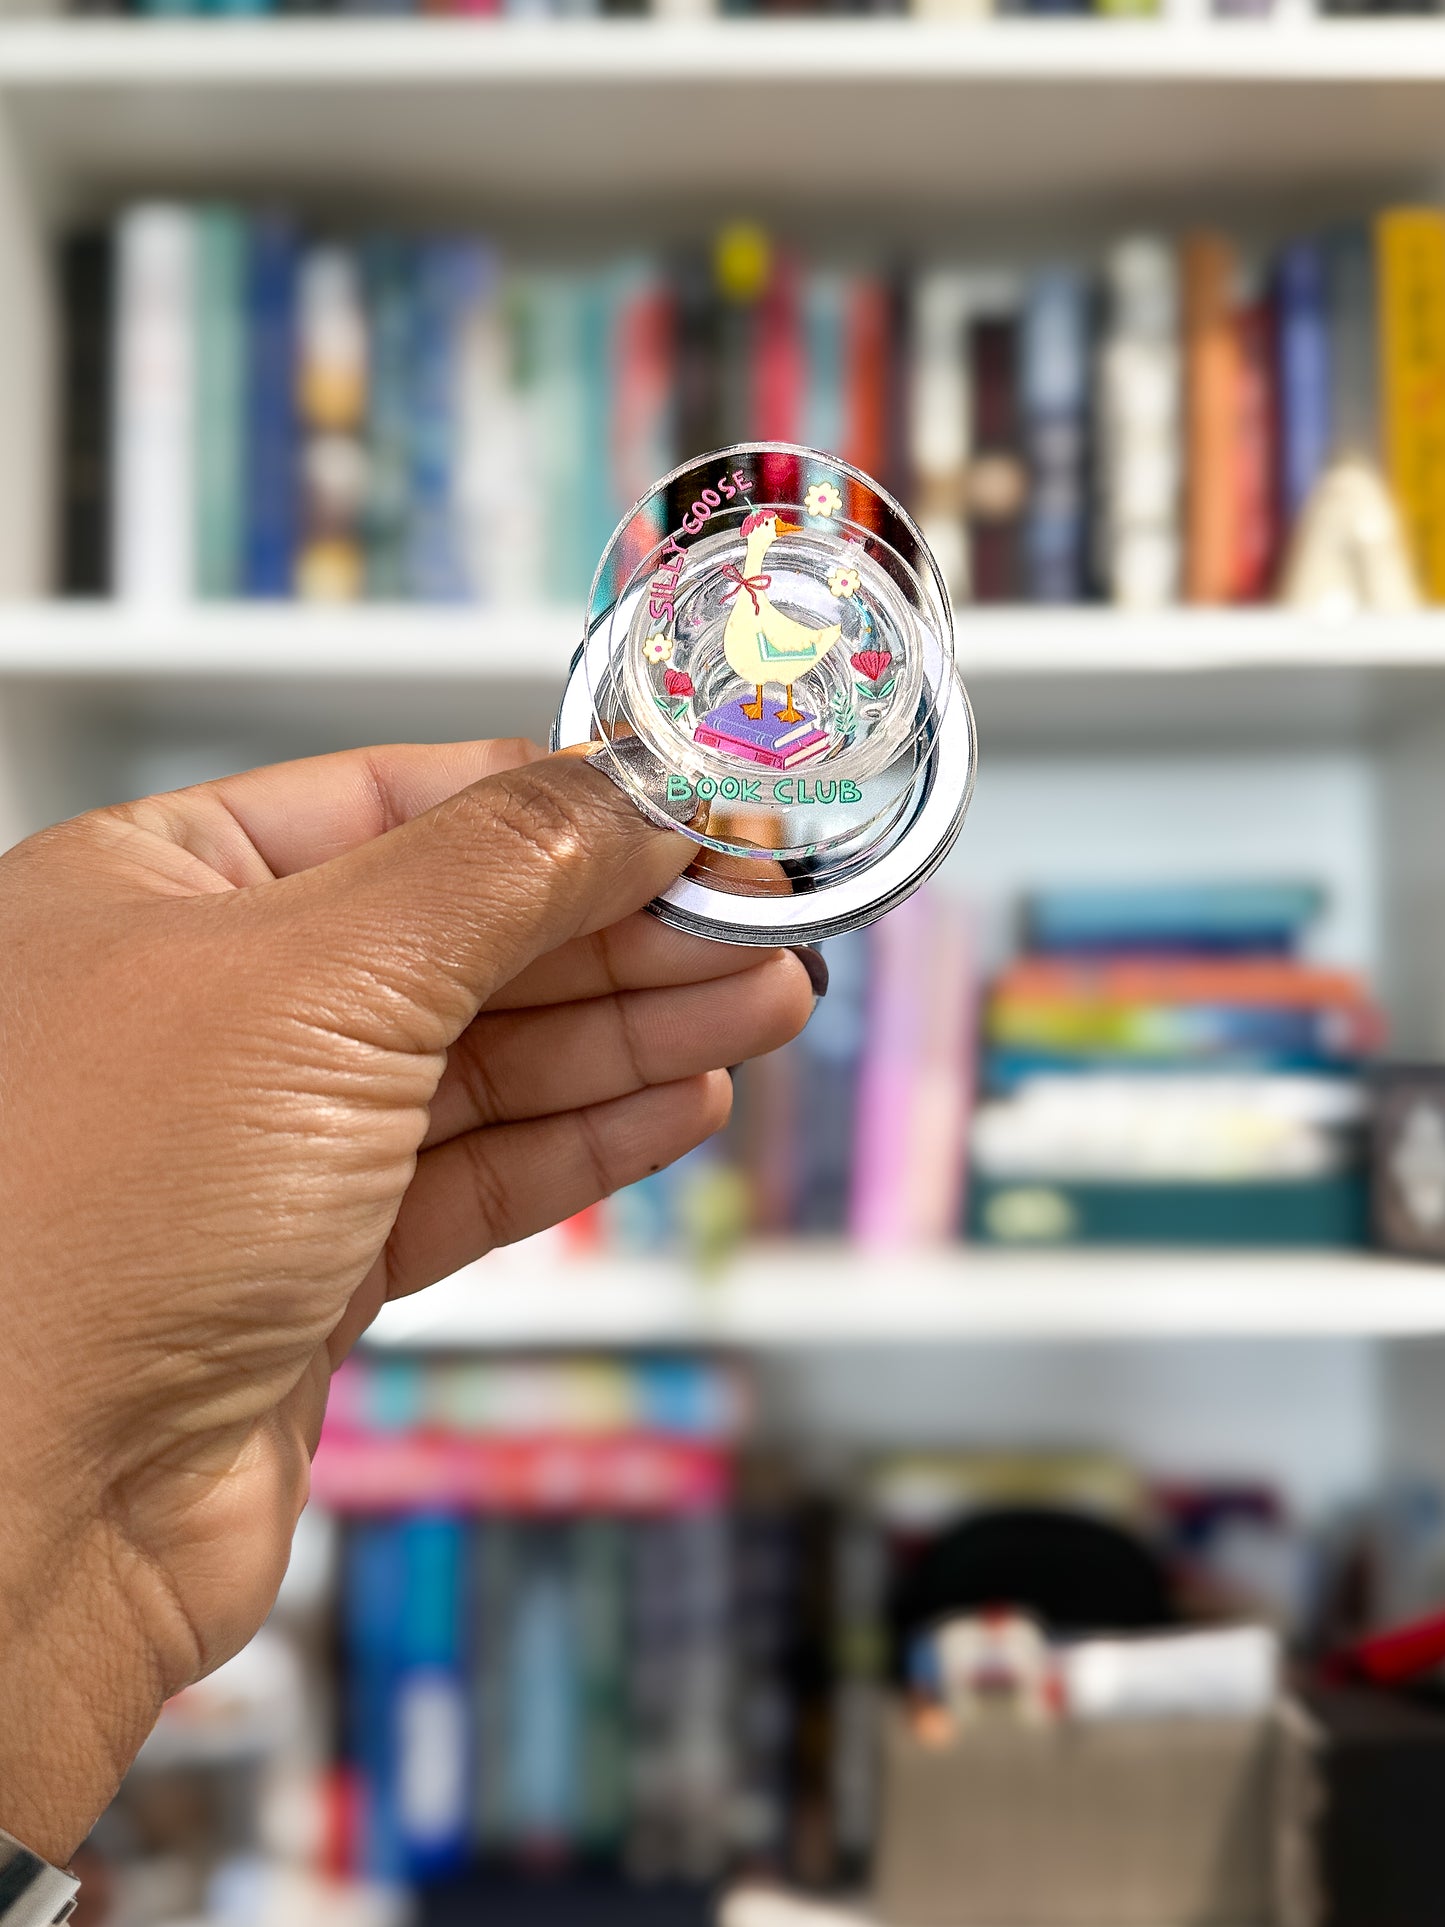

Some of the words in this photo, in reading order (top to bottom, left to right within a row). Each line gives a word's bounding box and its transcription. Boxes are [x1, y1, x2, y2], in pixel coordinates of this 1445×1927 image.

[650, 537, 688, 621] SILLY
[682, 470, 753, 535] GOOSE
[666, 775, 763, 803] BOOK
[773, 778, 862, 804] CLUB
